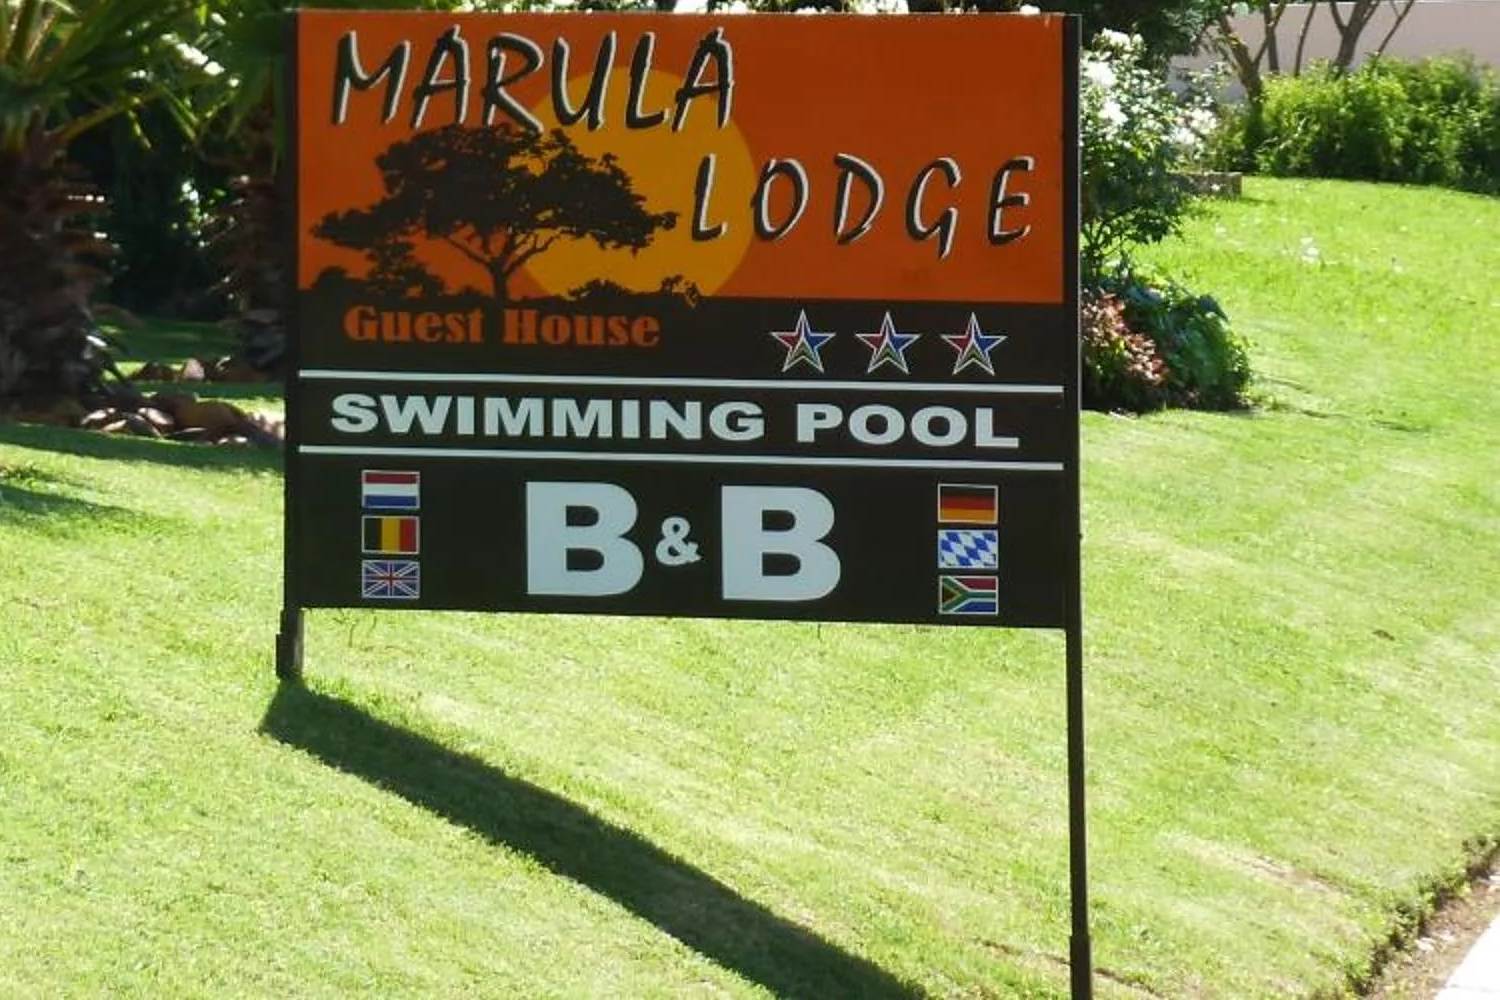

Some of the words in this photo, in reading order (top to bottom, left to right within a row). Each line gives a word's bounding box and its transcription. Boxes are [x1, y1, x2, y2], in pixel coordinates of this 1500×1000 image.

[331, 25, 735, 133] MARULA
[691, 153, 1036, 260] LODGE
[344, 307, 485, 345] Guest
[503, 308, 661, 347] House
[330, 392, 766, 442] SWIMMING
[797, 403, 1020, 449] POOL
